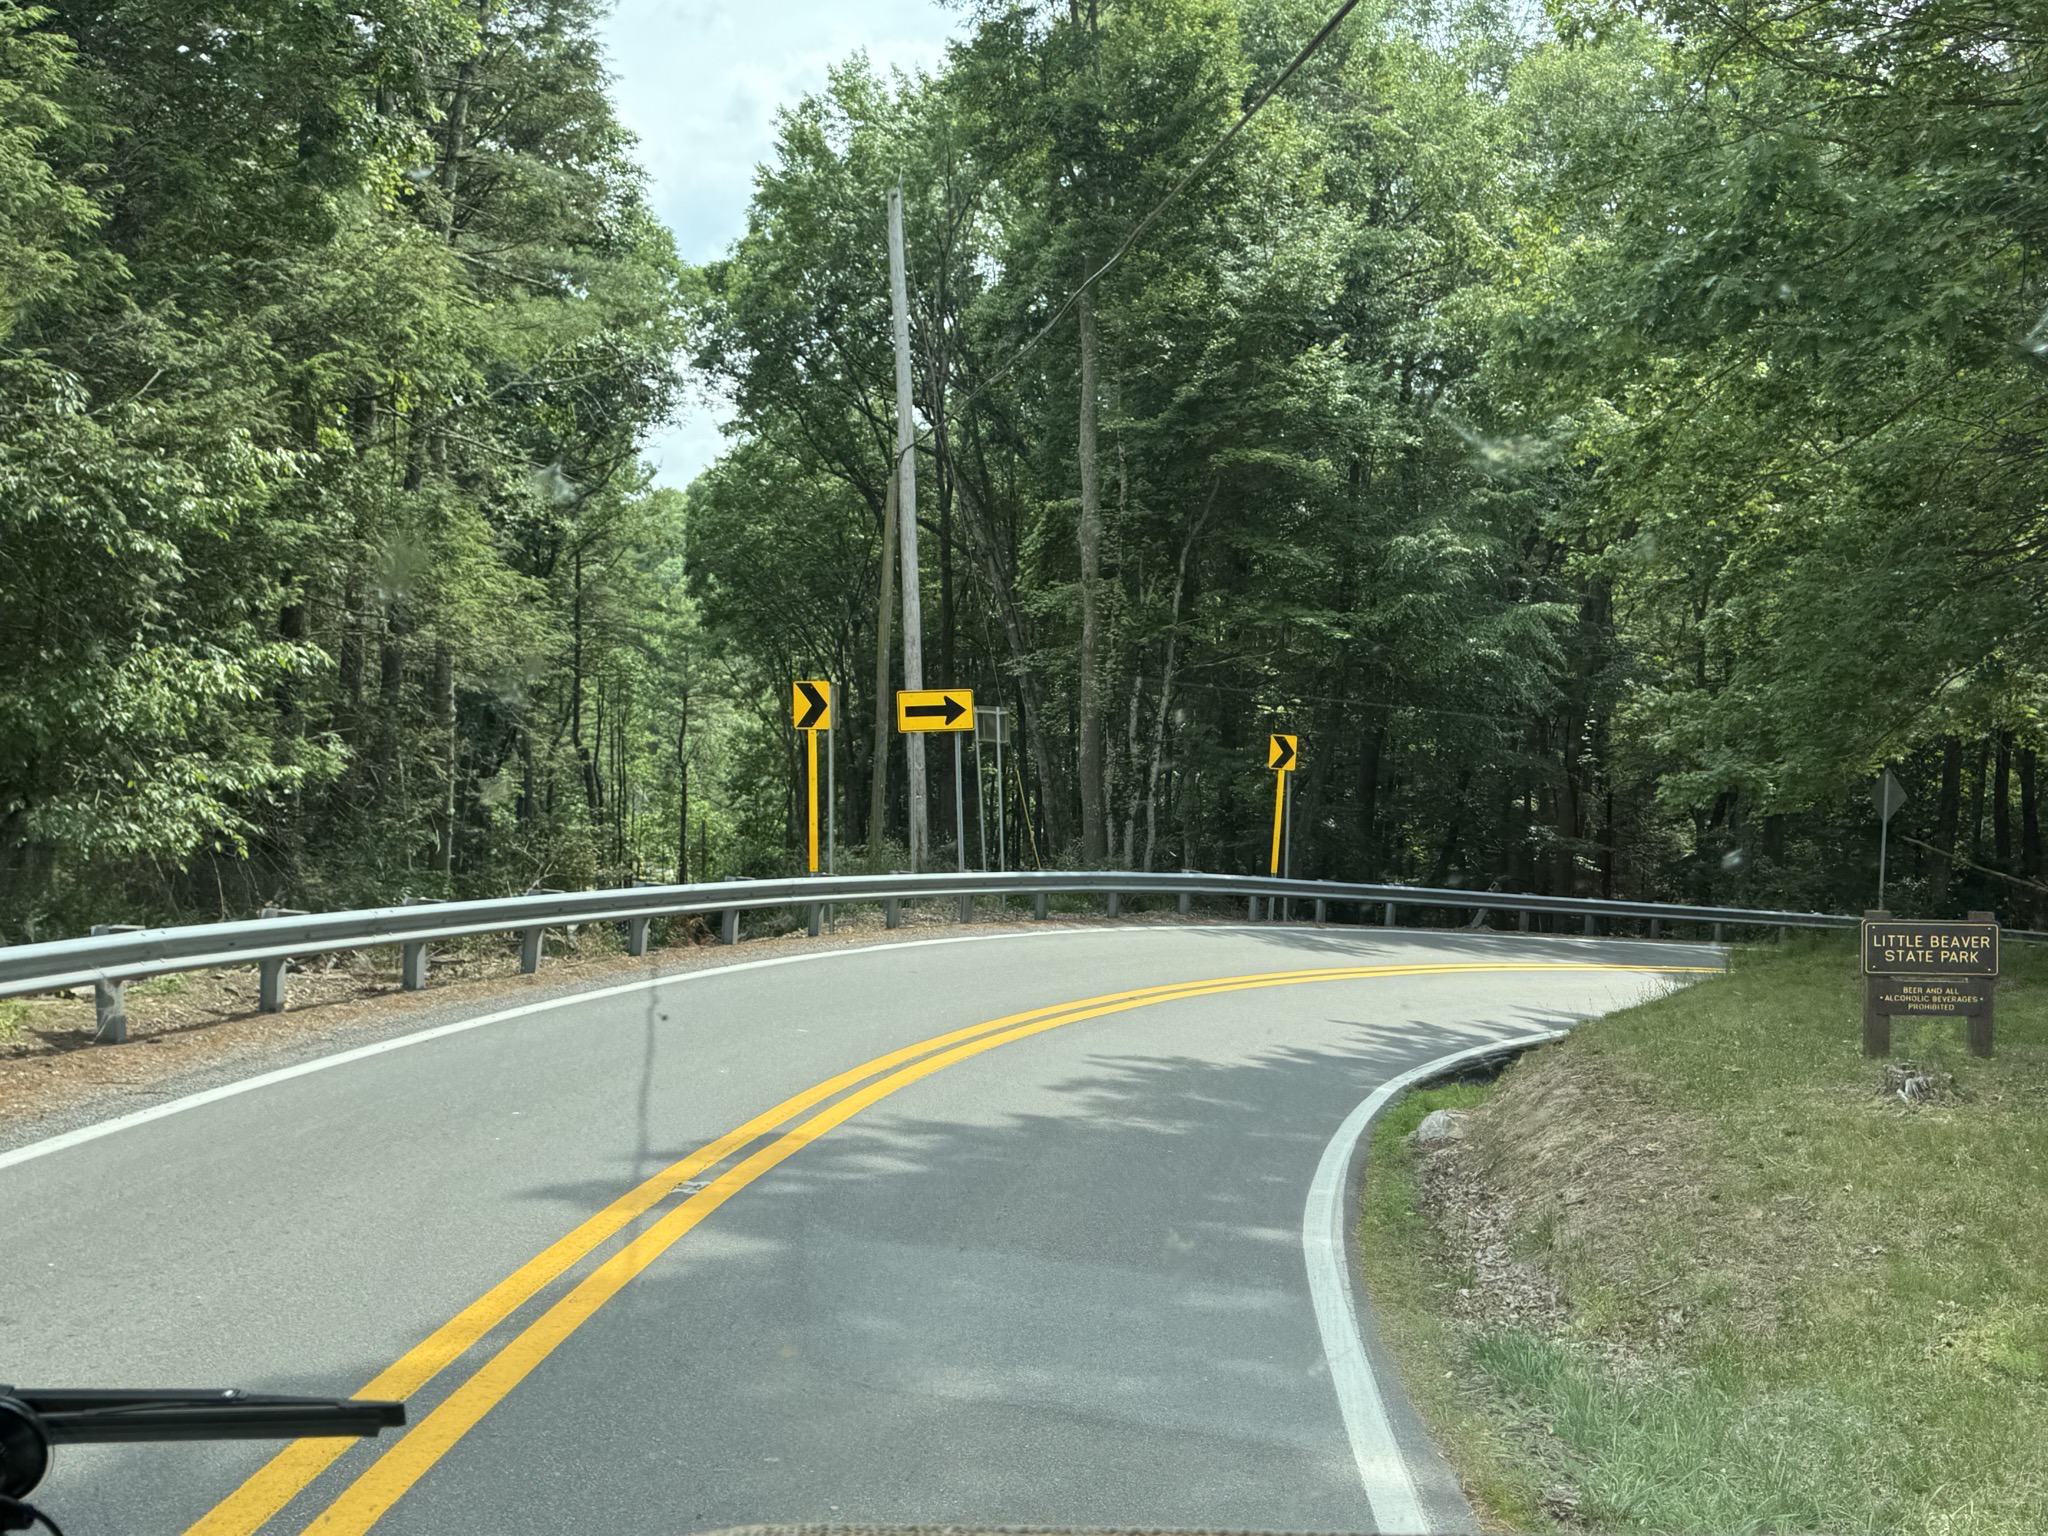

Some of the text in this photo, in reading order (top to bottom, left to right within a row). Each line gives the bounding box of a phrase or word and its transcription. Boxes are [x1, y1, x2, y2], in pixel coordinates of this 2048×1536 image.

[1873, 934, 1990, 949] LITTLE BEAVER
[1885, 949, 1979, 963] STATE PARK
[1932, 995, 1978, 1003] BEVERAGES
[1908, 1003, 1955, 1011] PROHIBITED
